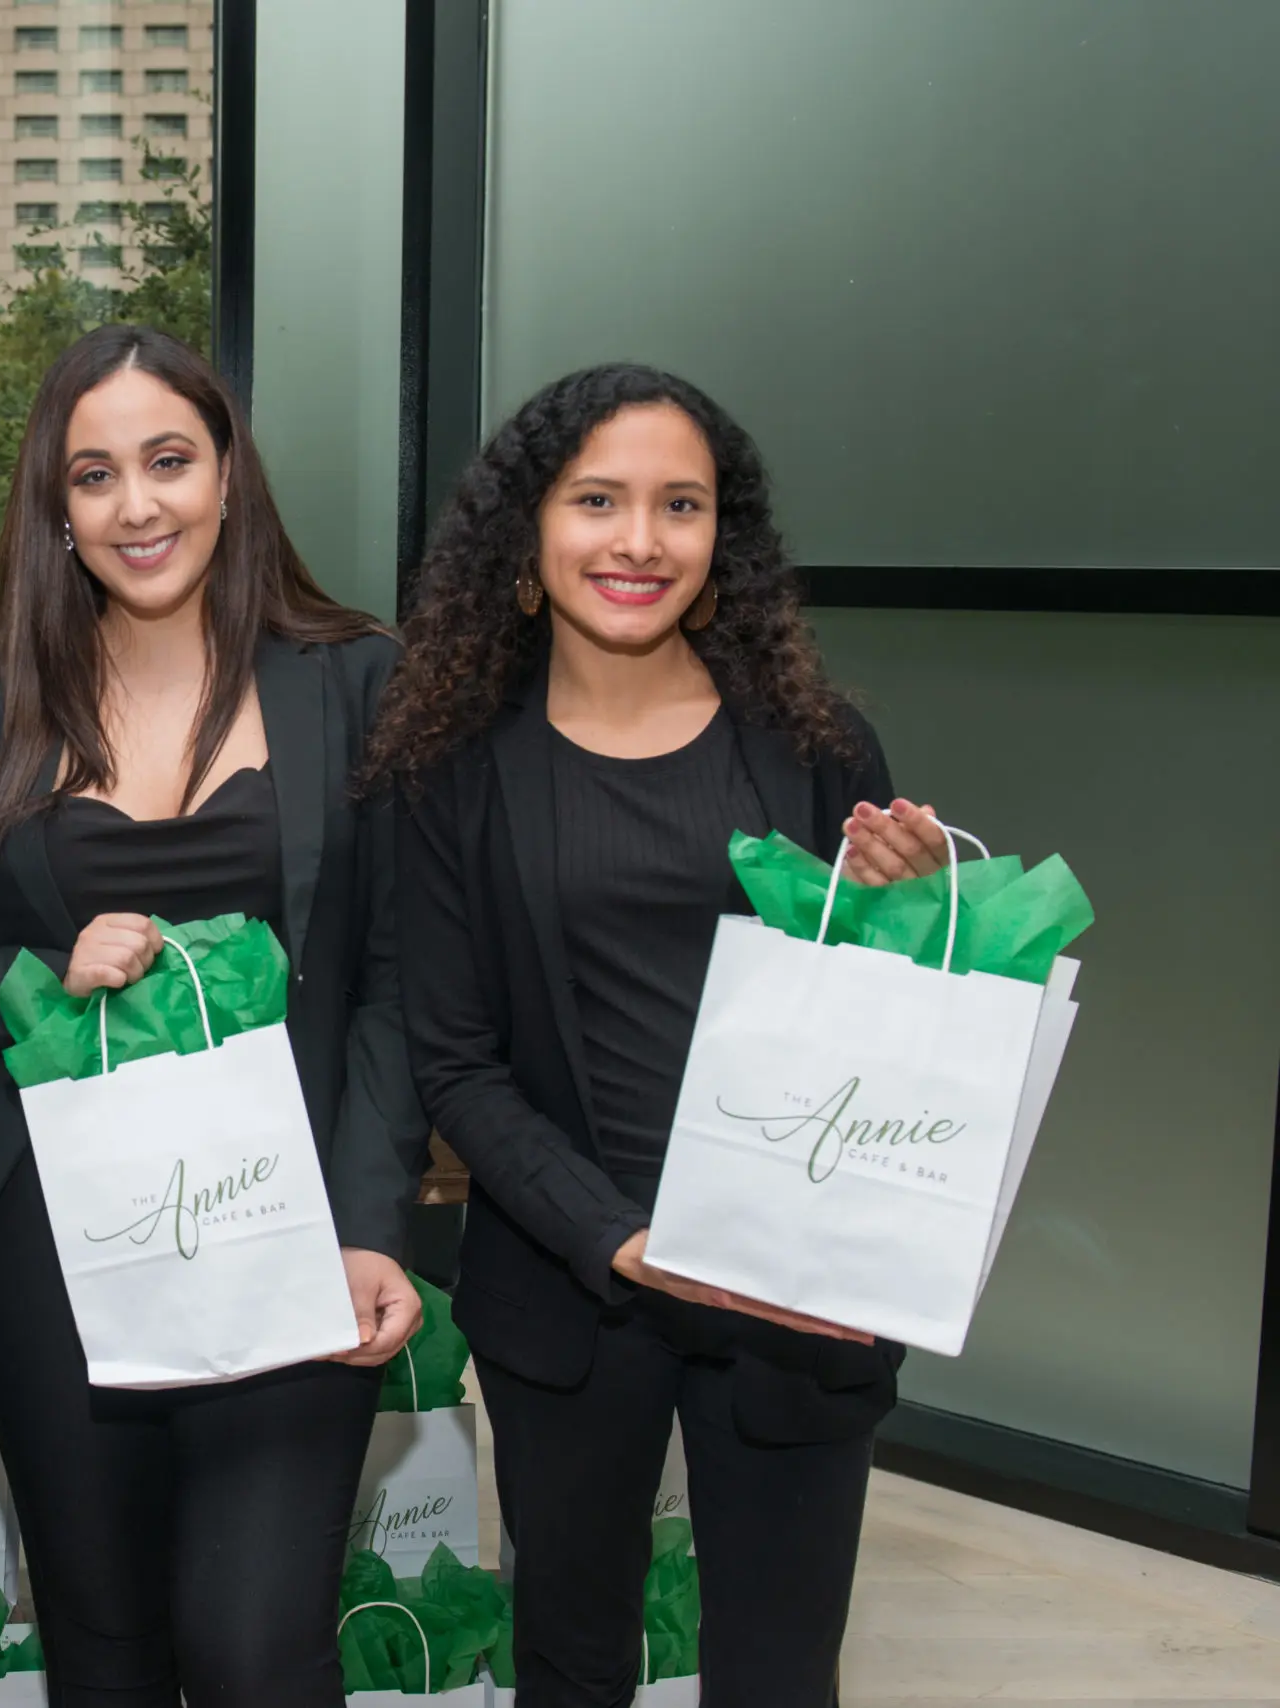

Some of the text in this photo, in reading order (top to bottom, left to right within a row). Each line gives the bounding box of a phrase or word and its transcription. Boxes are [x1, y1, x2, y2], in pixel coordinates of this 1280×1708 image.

[716, 1076, 966, 1184] THE Annie
[898, 1162, 907, 1172] &
[916, 1166, 948, 1184] BAR
[84, 1154, 279, 1260] THE Annie
[245, 1208, 253, 1218] &
[260, 1202, 286, 1215] BAR
[346, 1488, 454, 1558] Annie
[431, 1530, 450, 1538] BAR
